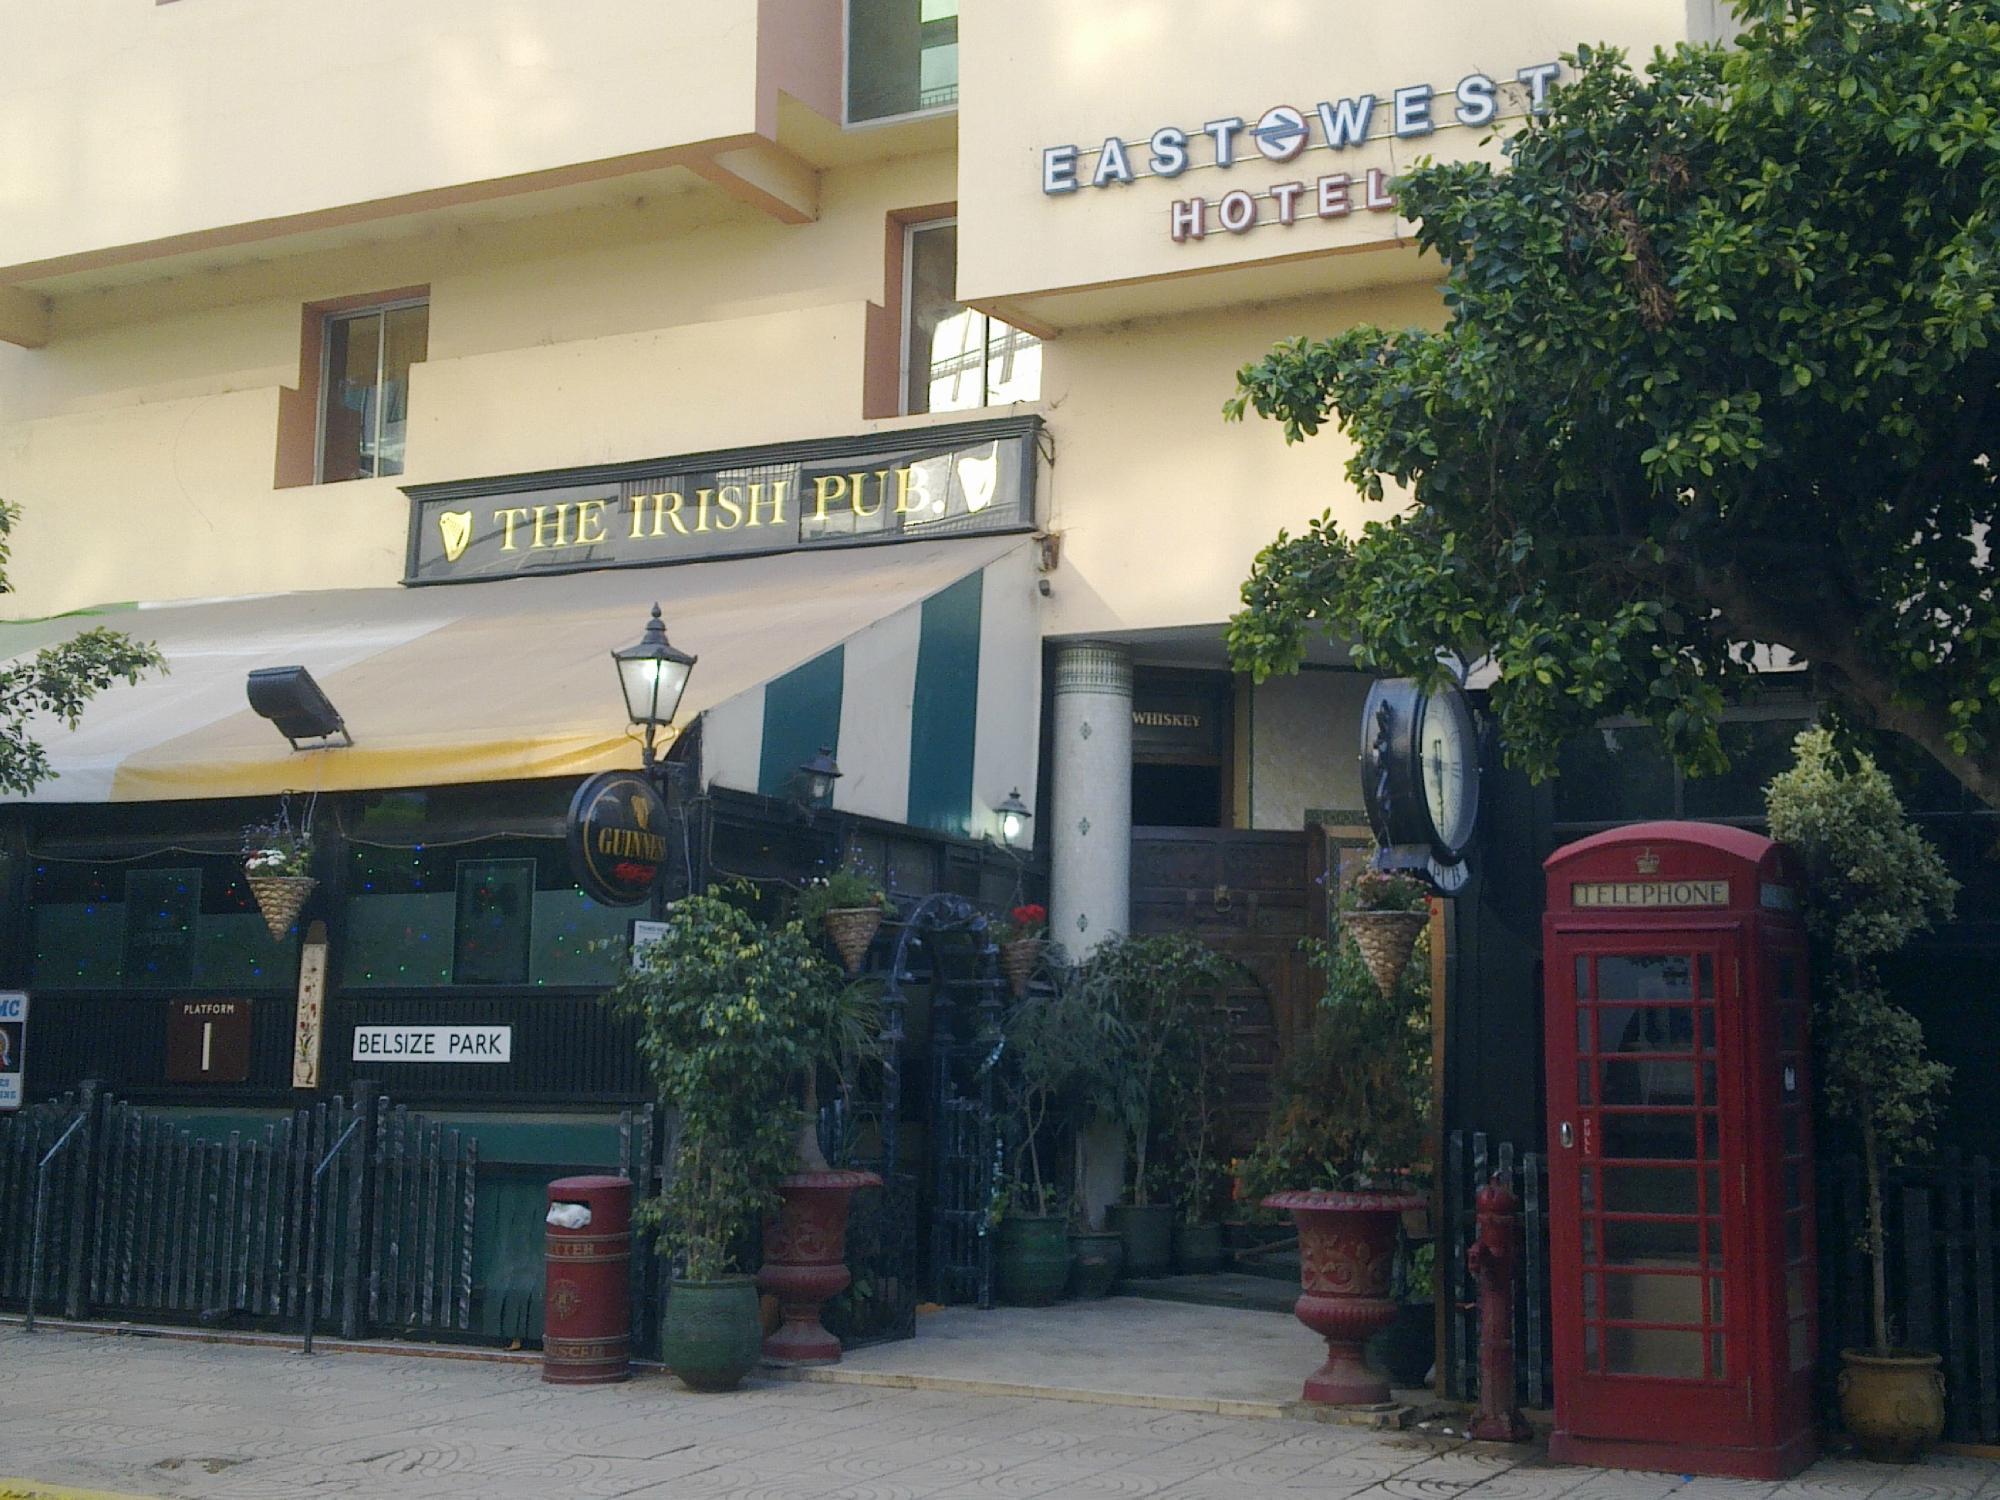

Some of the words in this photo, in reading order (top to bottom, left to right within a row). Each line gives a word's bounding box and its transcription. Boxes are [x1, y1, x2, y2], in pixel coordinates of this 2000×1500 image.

[1171, 168, 1393, 243] HOTEL
[493, 499, 608, 551] THE
[628, 481, 788, 539] IRISH
[1132, 711, 1201, 728] WHISKEY
[1582, 884, 1724, 905] TELEPHONE
[183, 1003, 235, 1015] PLATFORM
[358, 1033, 436, 1055] BELSIZE
[449, 1033, 503, 1055] PARK
